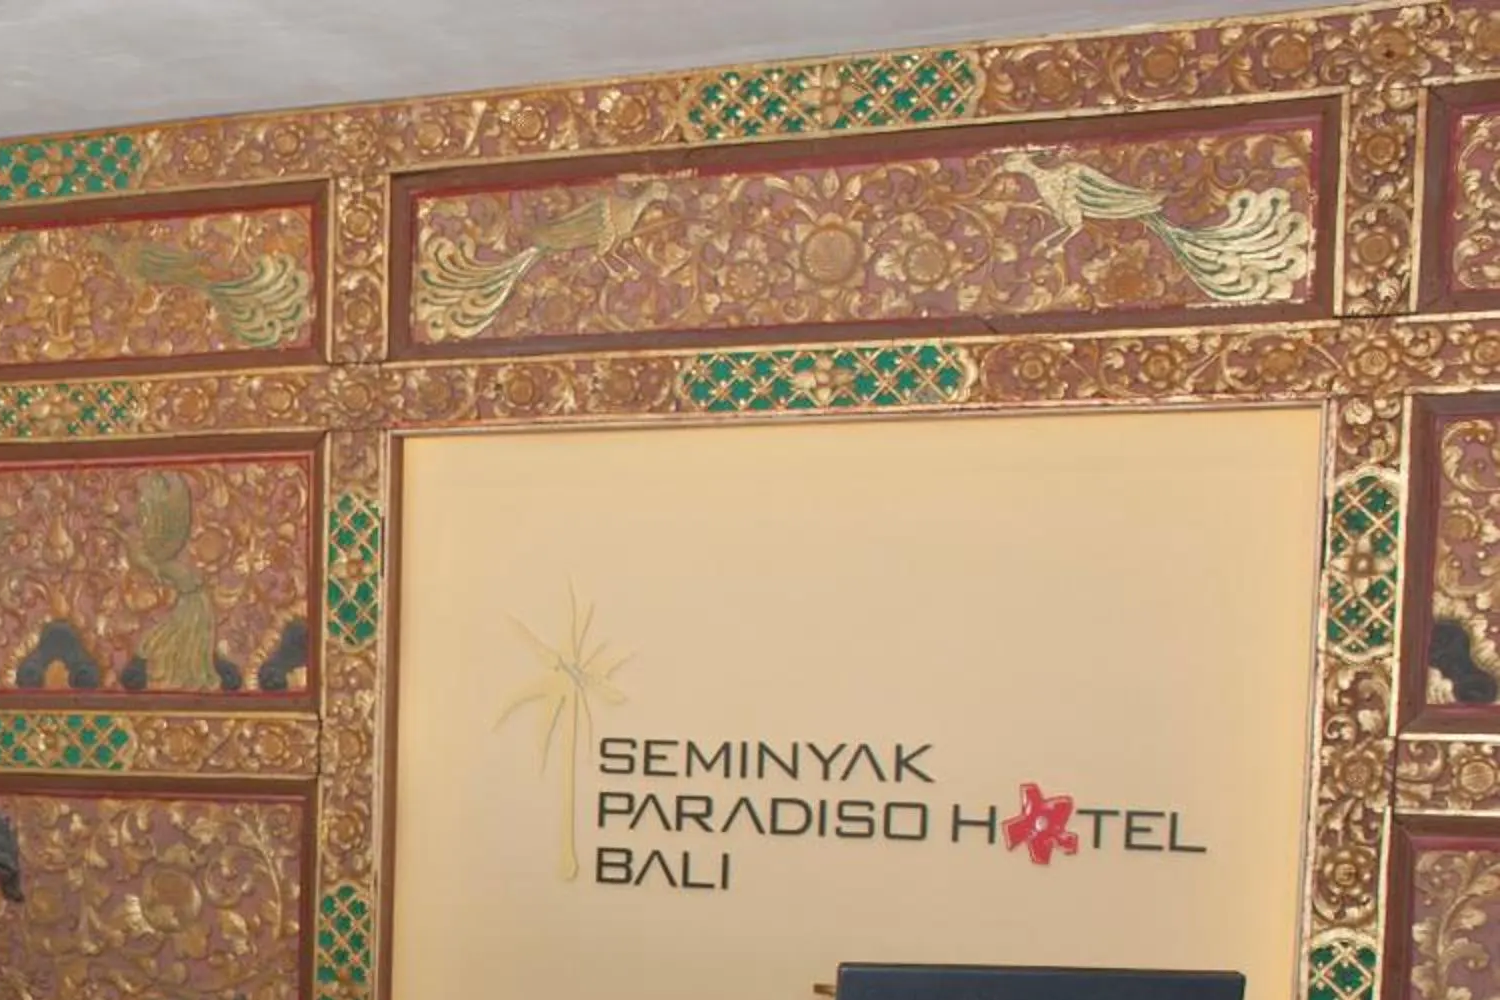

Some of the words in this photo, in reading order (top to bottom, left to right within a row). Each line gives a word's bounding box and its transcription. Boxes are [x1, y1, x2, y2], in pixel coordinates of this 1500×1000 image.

[600, 737, 934, 783] SEMINYAK
[598, 791, 928, 841] PARADISO
[595, 847, 730, 891] BALI
